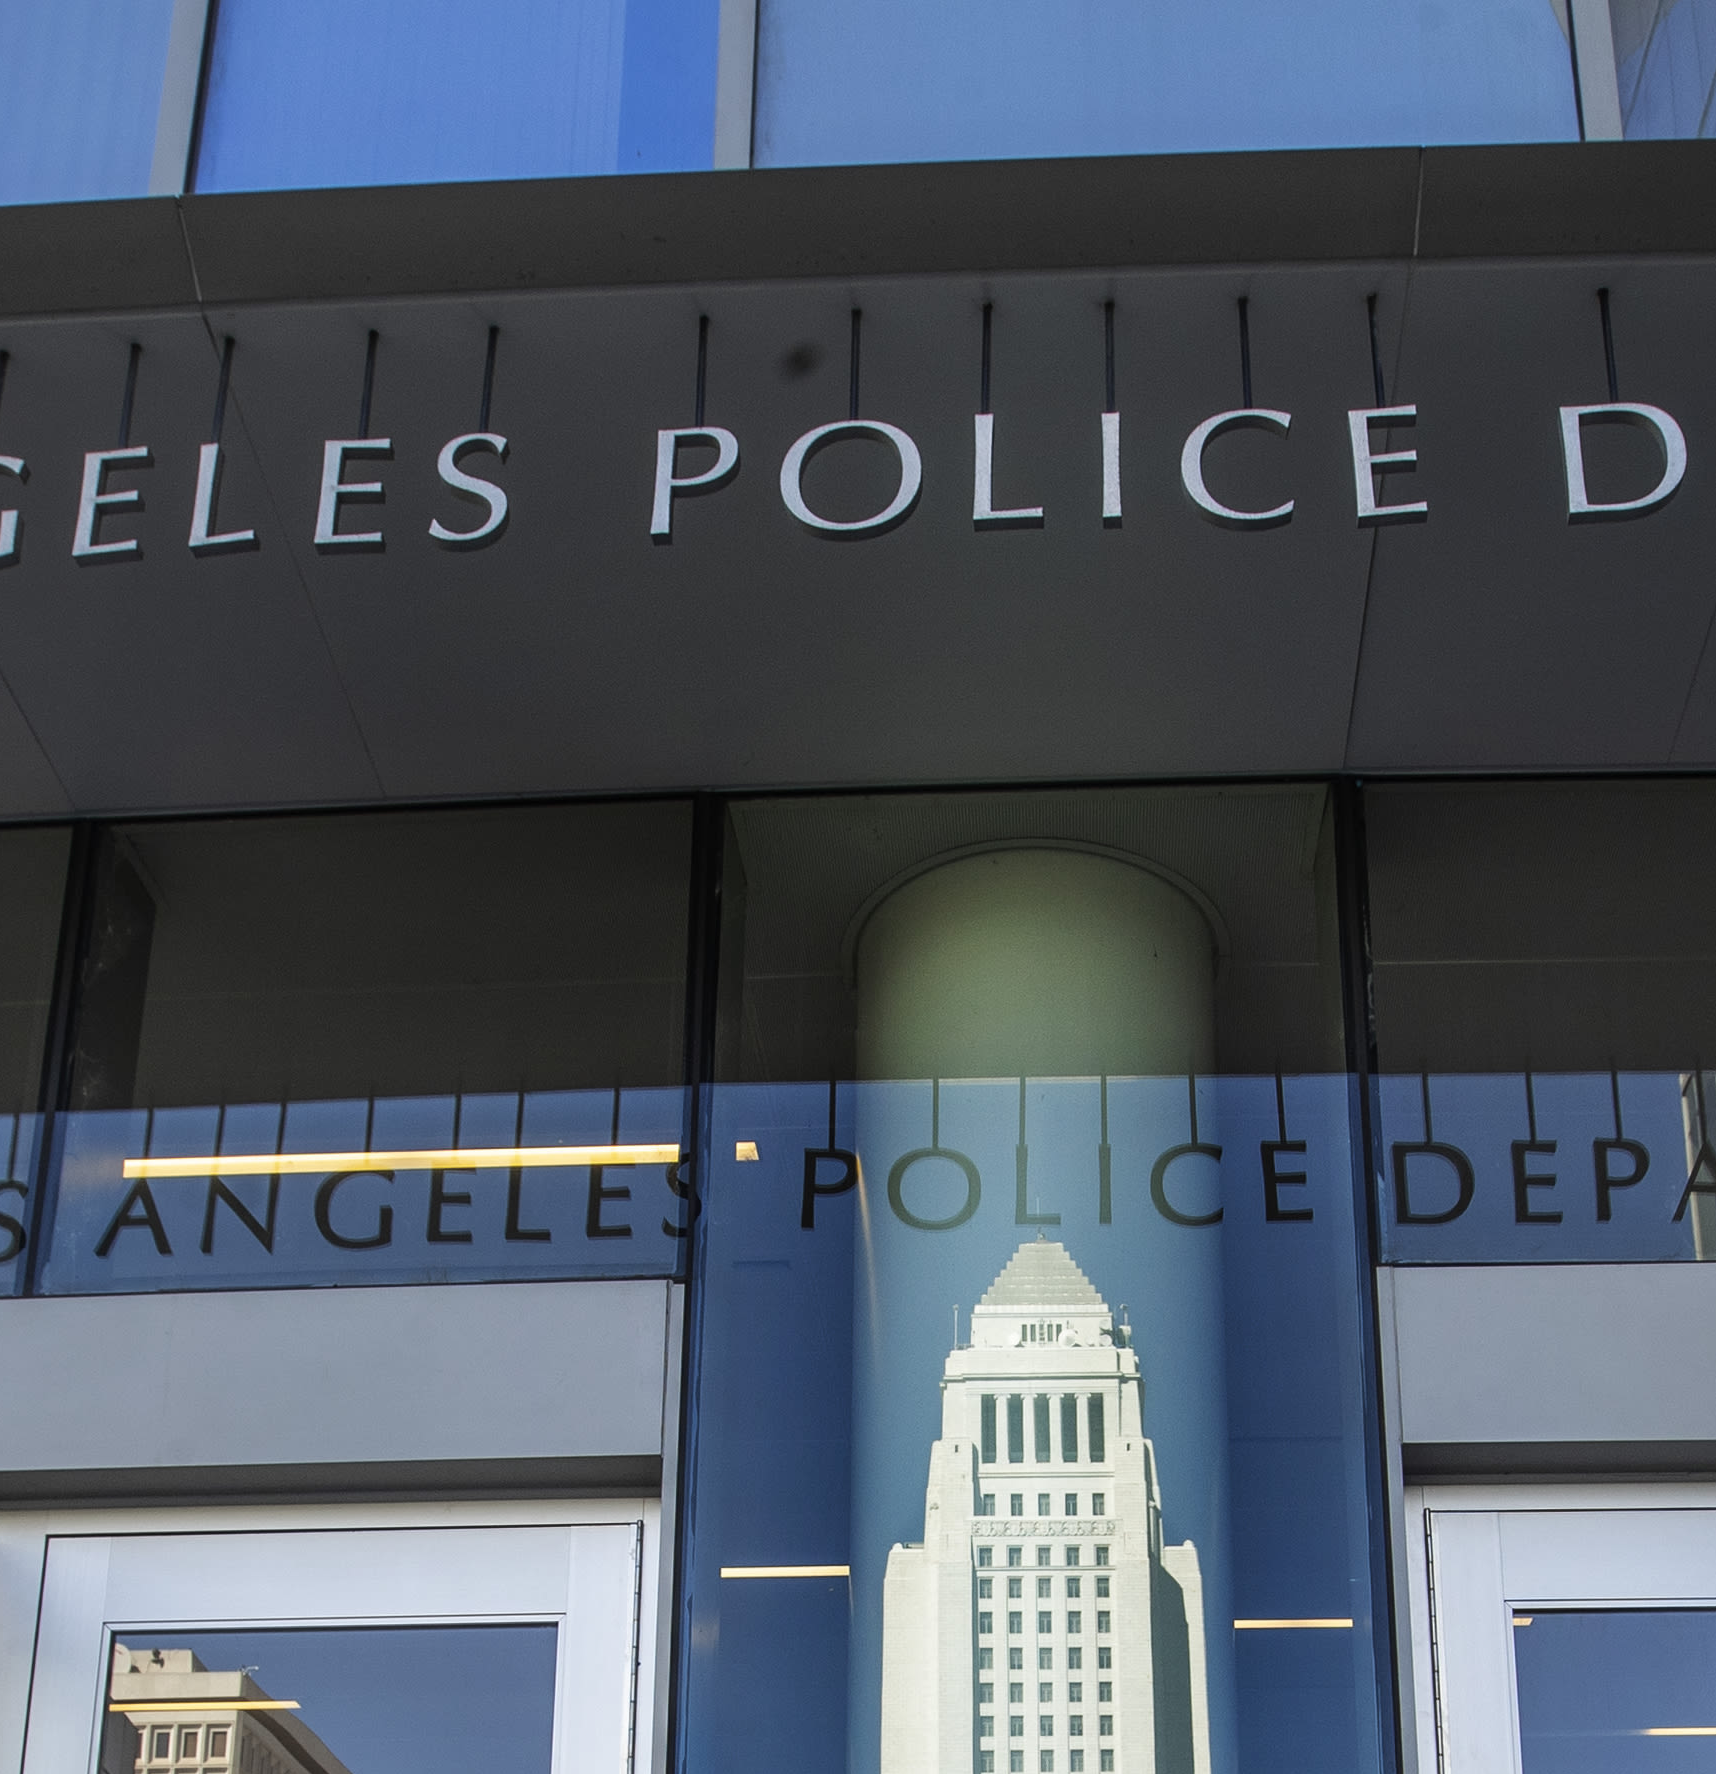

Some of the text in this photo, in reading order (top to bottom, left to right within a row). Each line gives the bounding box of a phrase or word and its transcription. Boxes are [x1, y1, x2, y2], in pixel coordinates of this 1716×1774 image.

[650, 404, 1430, 535] POLICE
[94, 1148, 701, 1257] ANGELES
[799, 1138, 1315, 1231] POLICE
